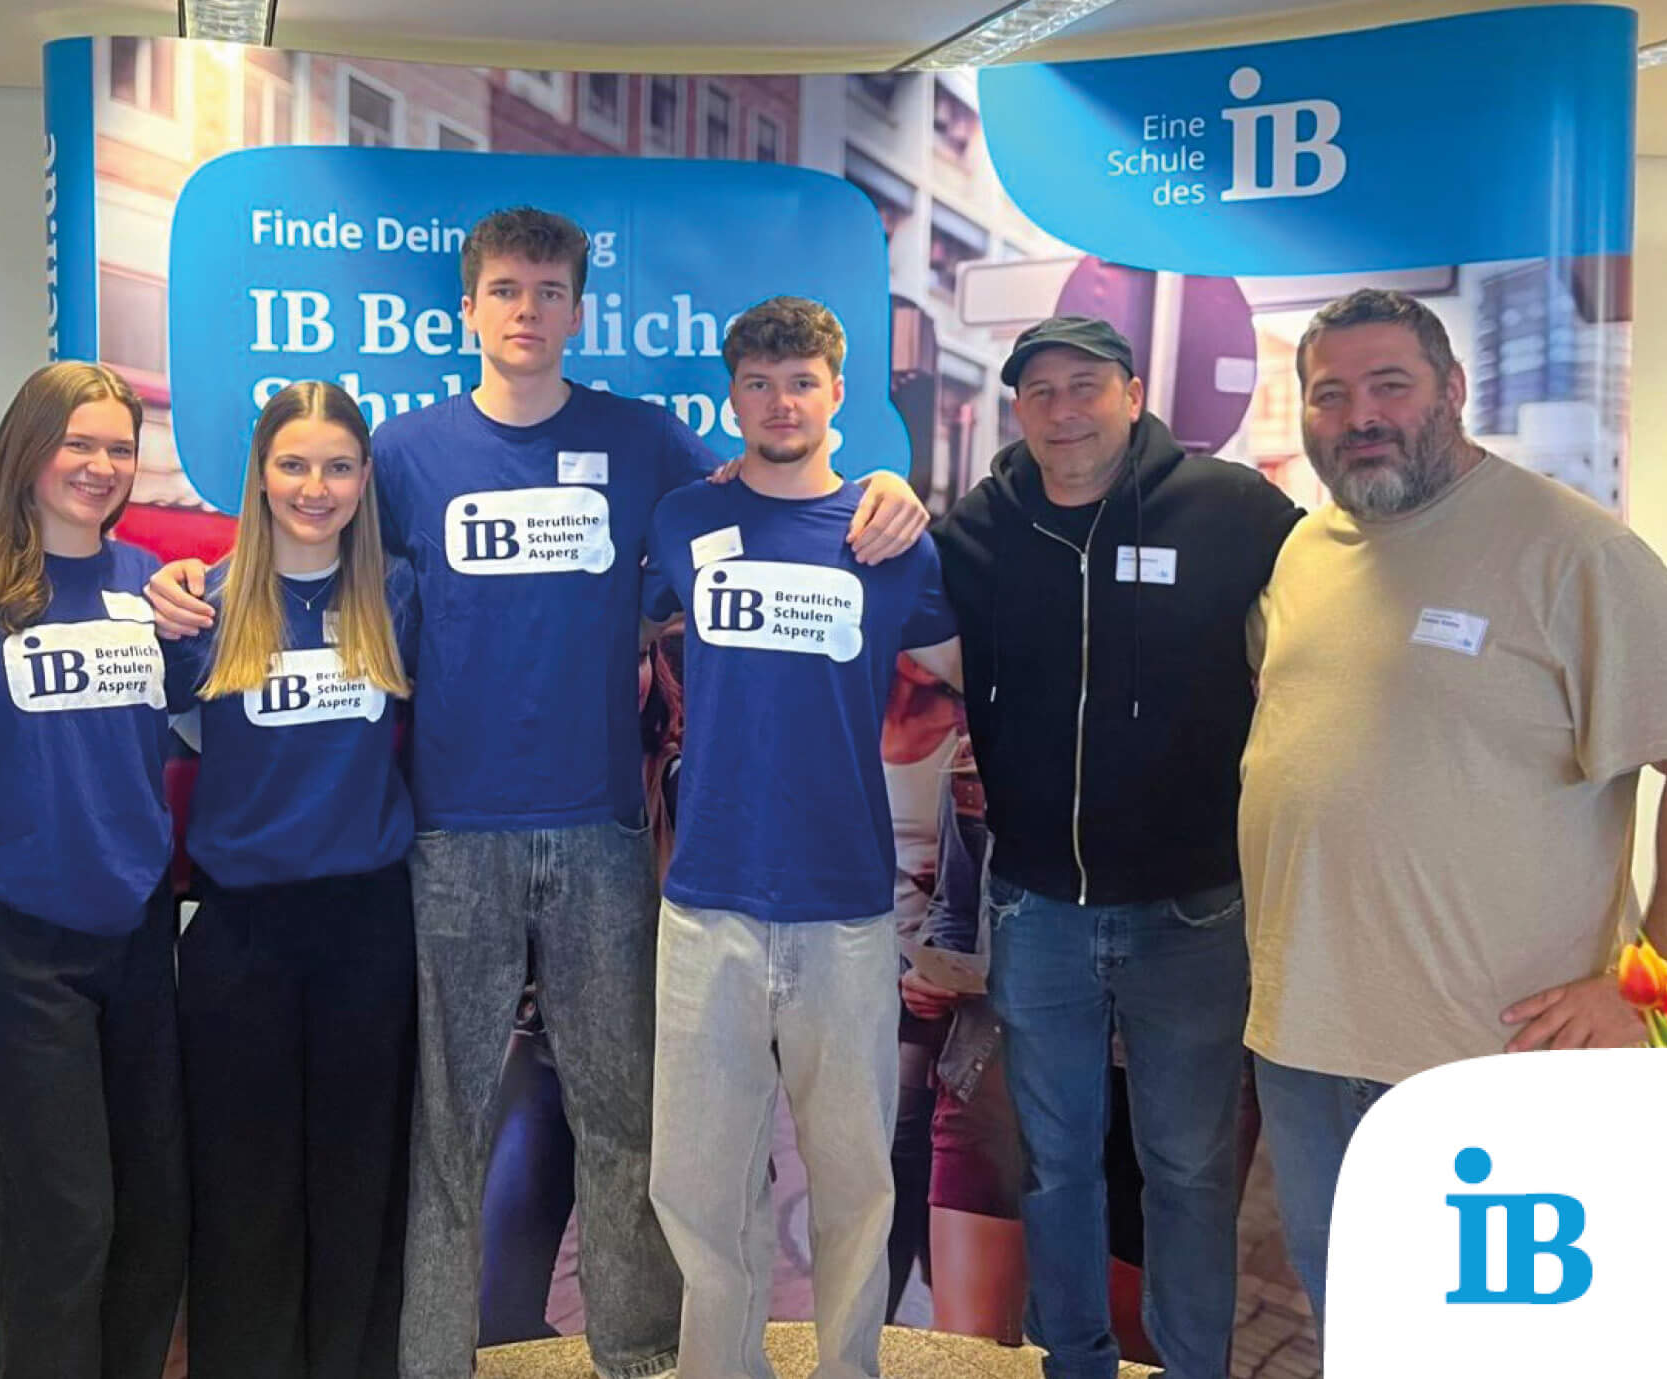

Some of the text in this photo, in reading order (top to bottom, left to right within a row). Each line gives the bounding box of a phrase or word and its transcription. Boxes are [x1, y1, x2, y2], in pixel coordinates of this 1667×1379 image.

[1143, 114, 1206, 141] Eine
[1107, 146, 1206, 177] Schule
[1153, 180, 1206, 206] des
[251, 209, 467, 253] Finde Dein
[249, 289, 334, 353] IB
[527, 515, 600, 529] Berufliche
[527, 532, 584, 544] Schulen
[528, 548, 580, 561] Asperg
[774, 590, 852, 610] Berufliche
[774, 606, 834, 624] Schulen
[772, 623, 826, 643] Asperg
[97, 662, 153, 676] Schulen
[97, 679, 148, 694] Asperg
[317, 681, 366, 695] Schulen
[317, 696, 362, 710] Asperg
